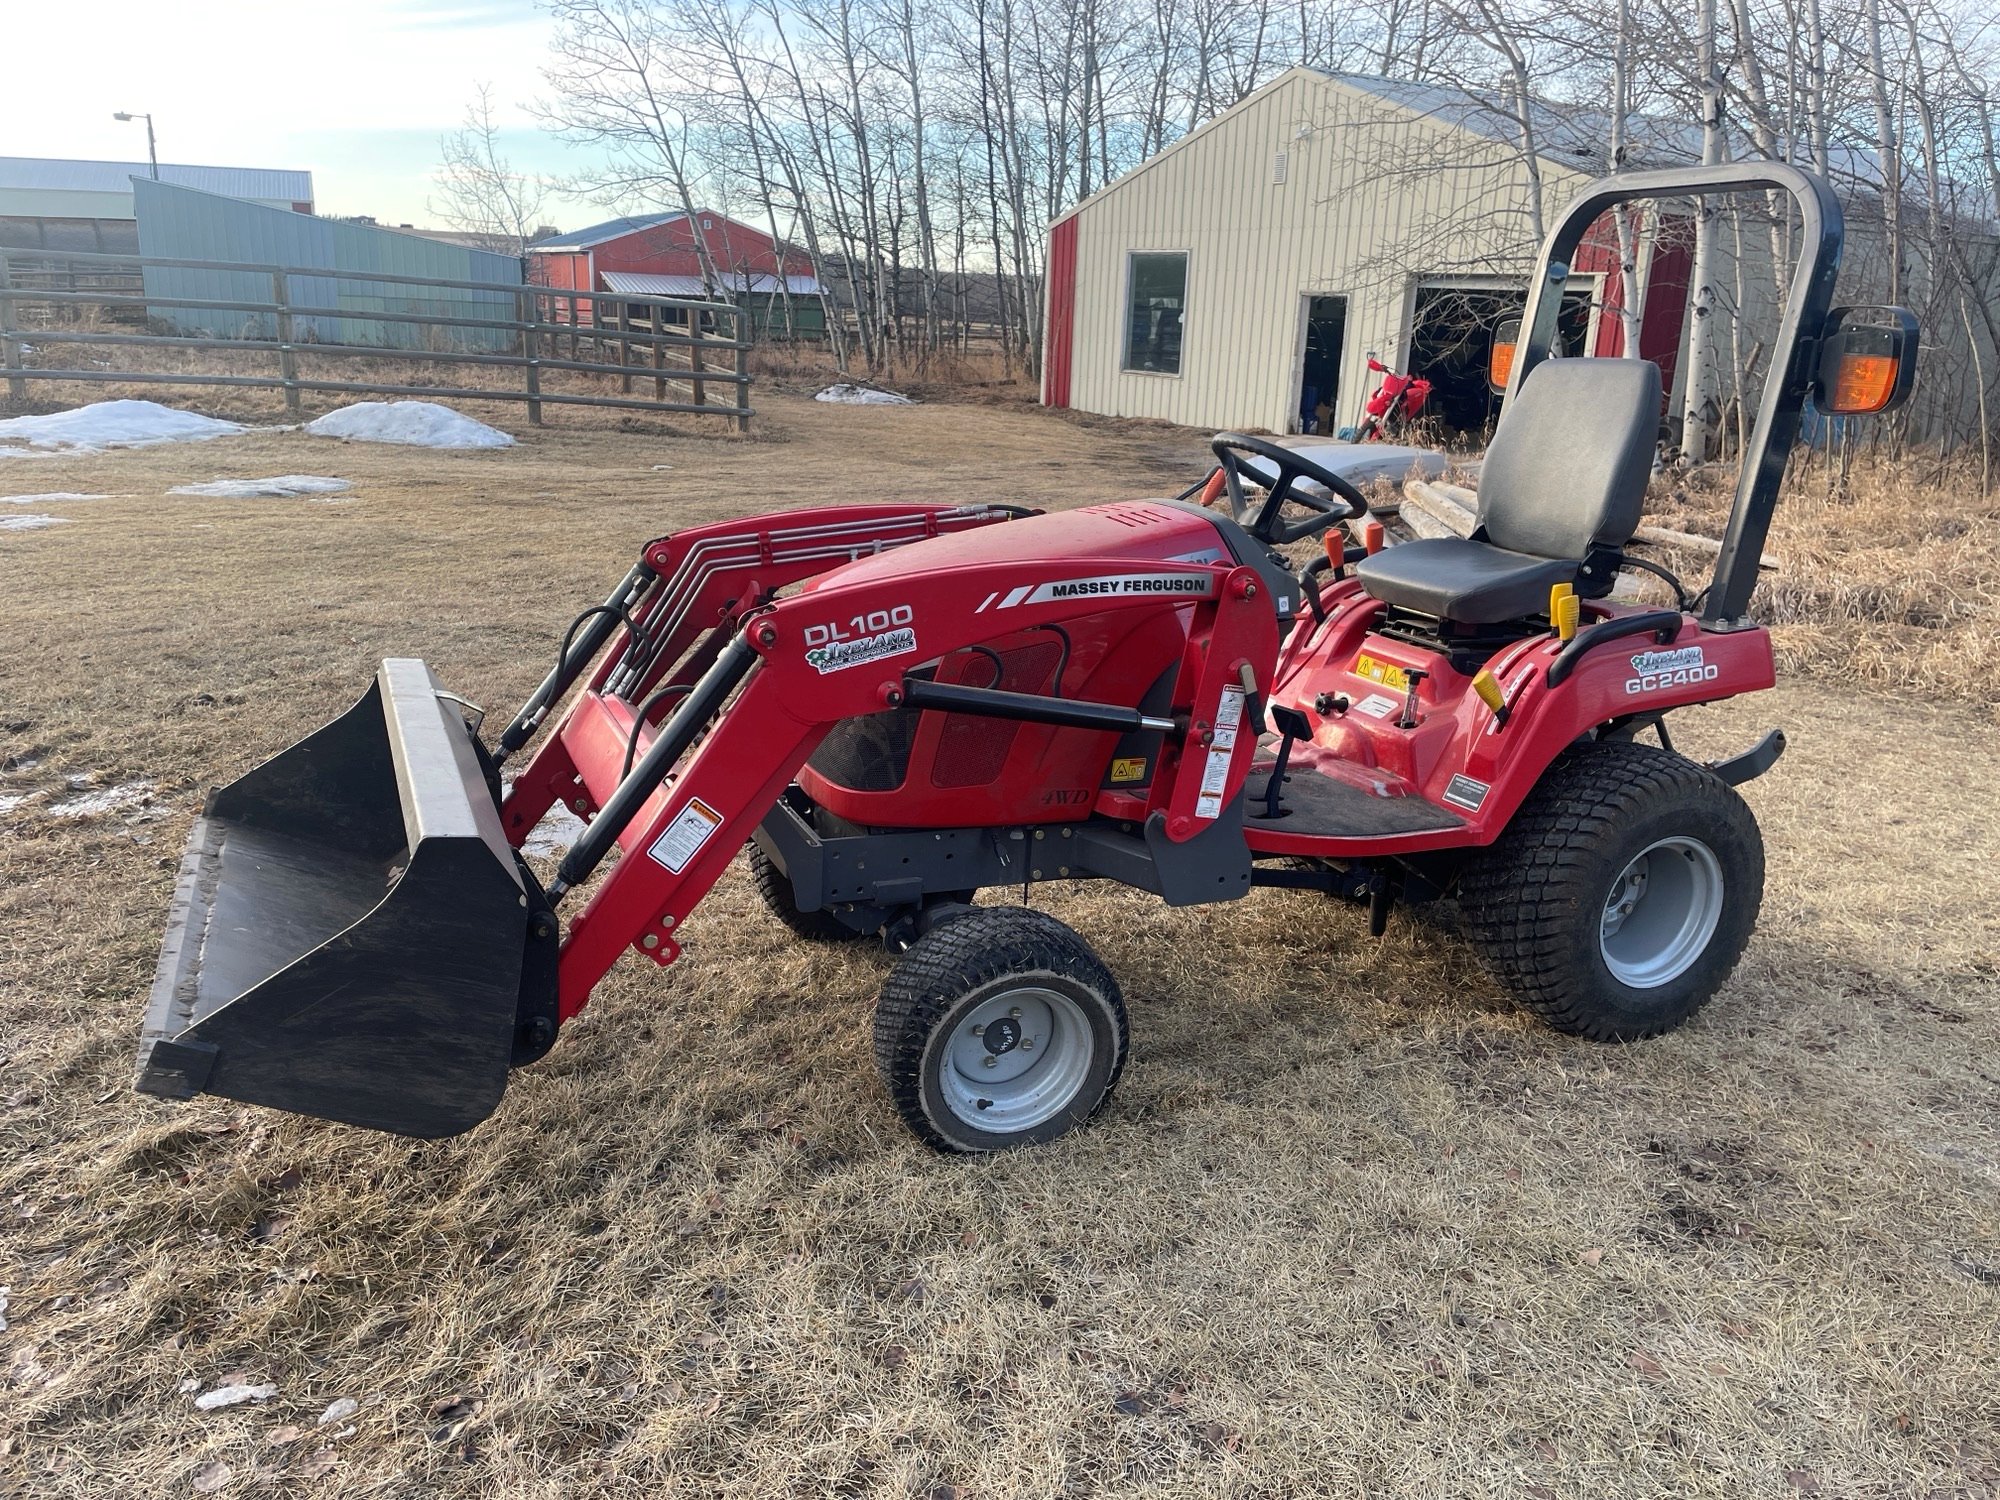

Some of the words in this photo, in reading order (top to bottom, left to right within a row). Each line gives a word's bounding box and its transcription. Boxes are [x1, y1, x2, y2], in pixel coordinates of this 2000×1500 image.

[1052, 581, 1120, 597] MASSEY
[1123, 579, 1205, 592] FERGUSON
[804, 605, 913, 646] DL100
[826, 629, 913, 658] IRELAND
[1626, 665, 1718, 694] GC2400
[1042, 789, 1089, 805] 4WD
